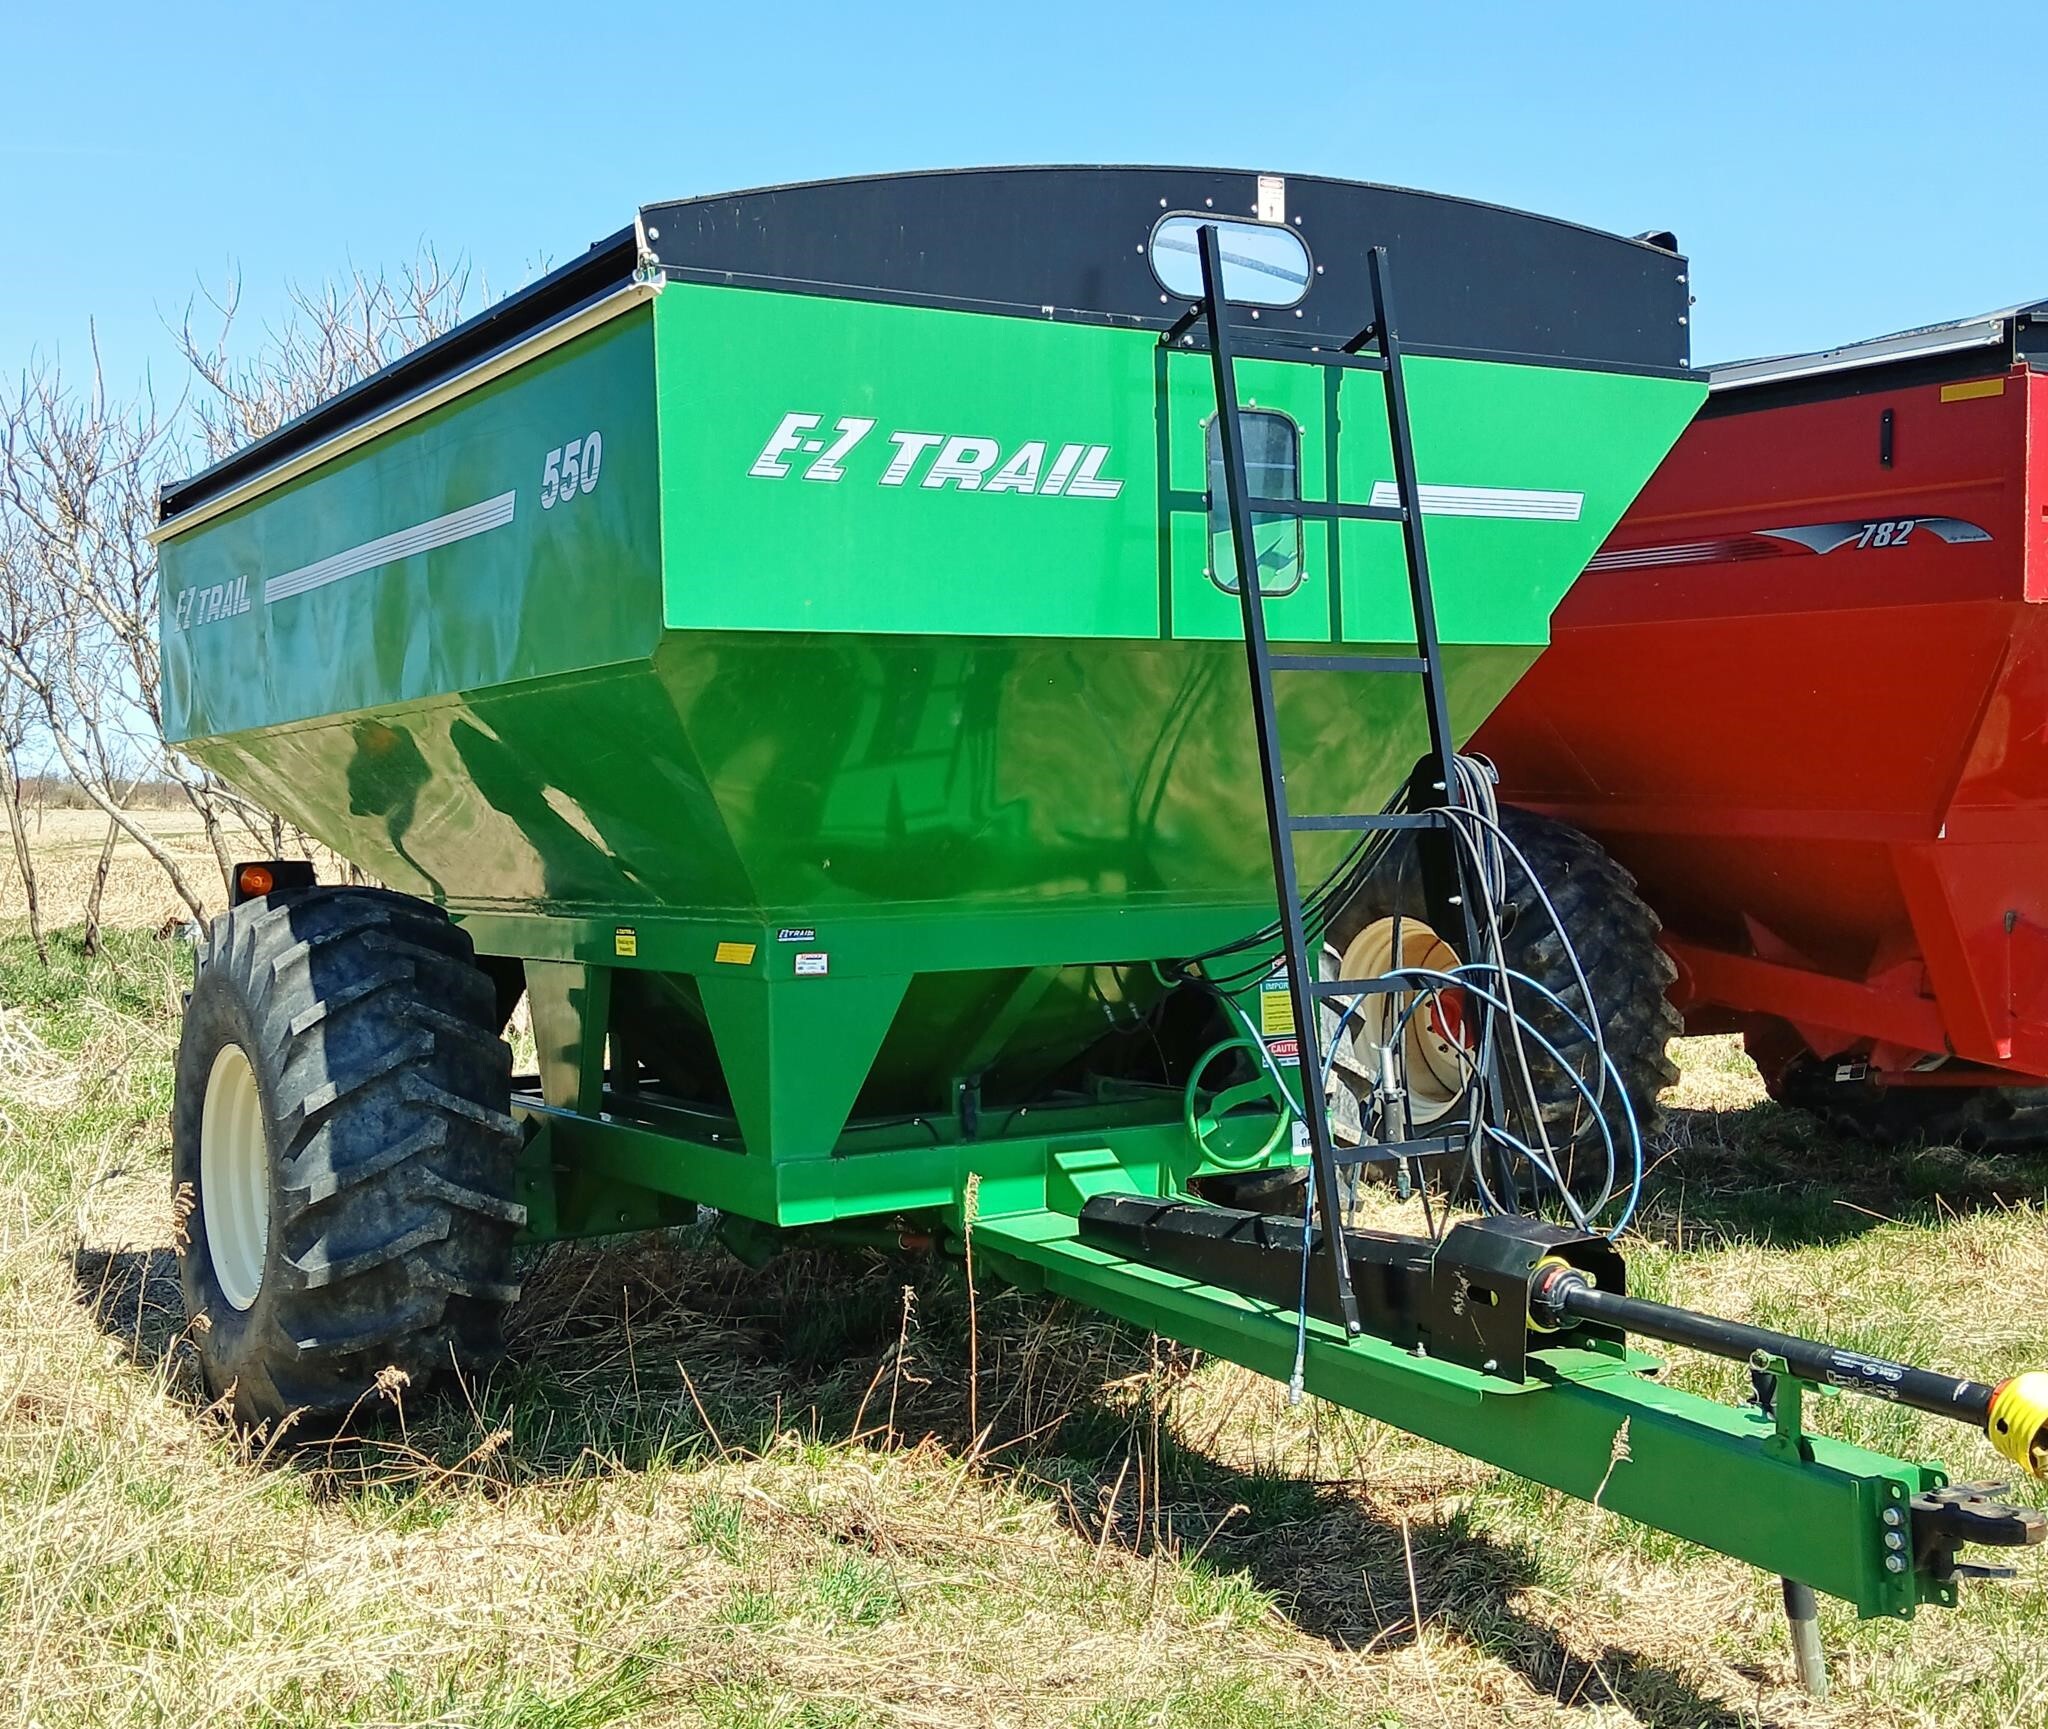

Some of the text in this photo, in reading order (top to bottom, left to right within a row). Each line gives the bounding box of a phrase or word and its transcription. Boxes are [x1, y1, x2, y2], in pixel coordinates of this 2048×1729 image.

[540, 429, 602, 510] 550
[748, 412, 1124, 498] E-Z TRAIL
[1856, 520, 1915, 549] 782
[197, 574, 251, 626] TRAIL
[1265, 981, 1289, 990] IMPOR
